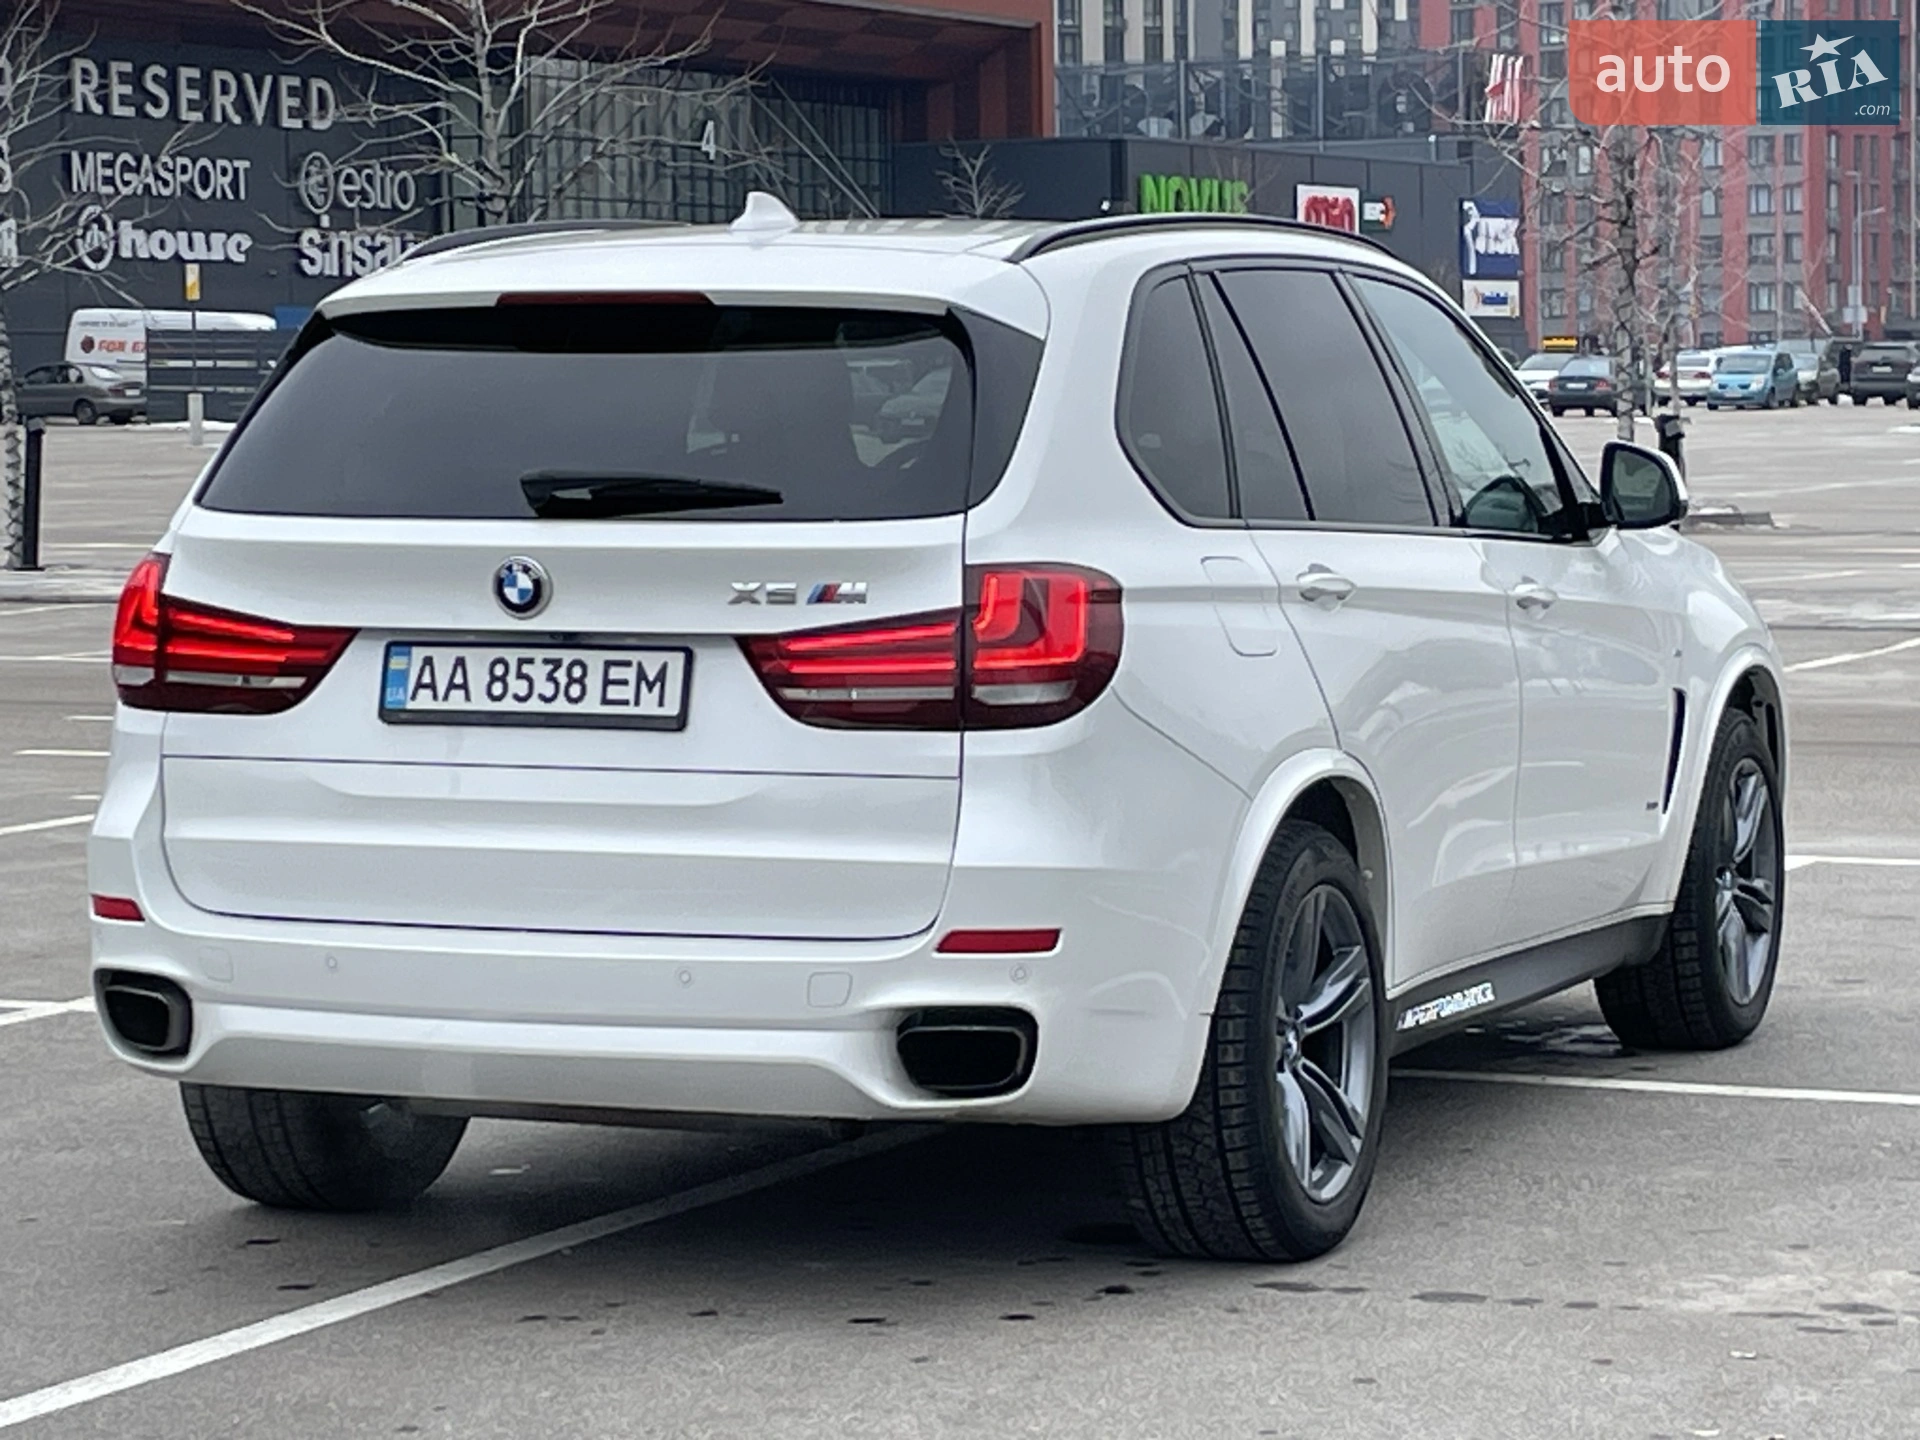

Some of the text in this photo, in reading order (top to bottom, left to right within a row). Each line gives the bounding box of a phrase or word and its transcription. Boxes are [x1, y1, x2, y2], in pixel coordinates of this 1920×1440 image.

[70, 57, 336, 131] RESERVED
[701, 119, 716, 160] 4
[70, 150, 251, 200] MEGASPORT
[338, 159, 416, 211] estro
[1140, 174, 1249, 214] NOVUS
[410, 654, 667, 708] AA 8538 EM
